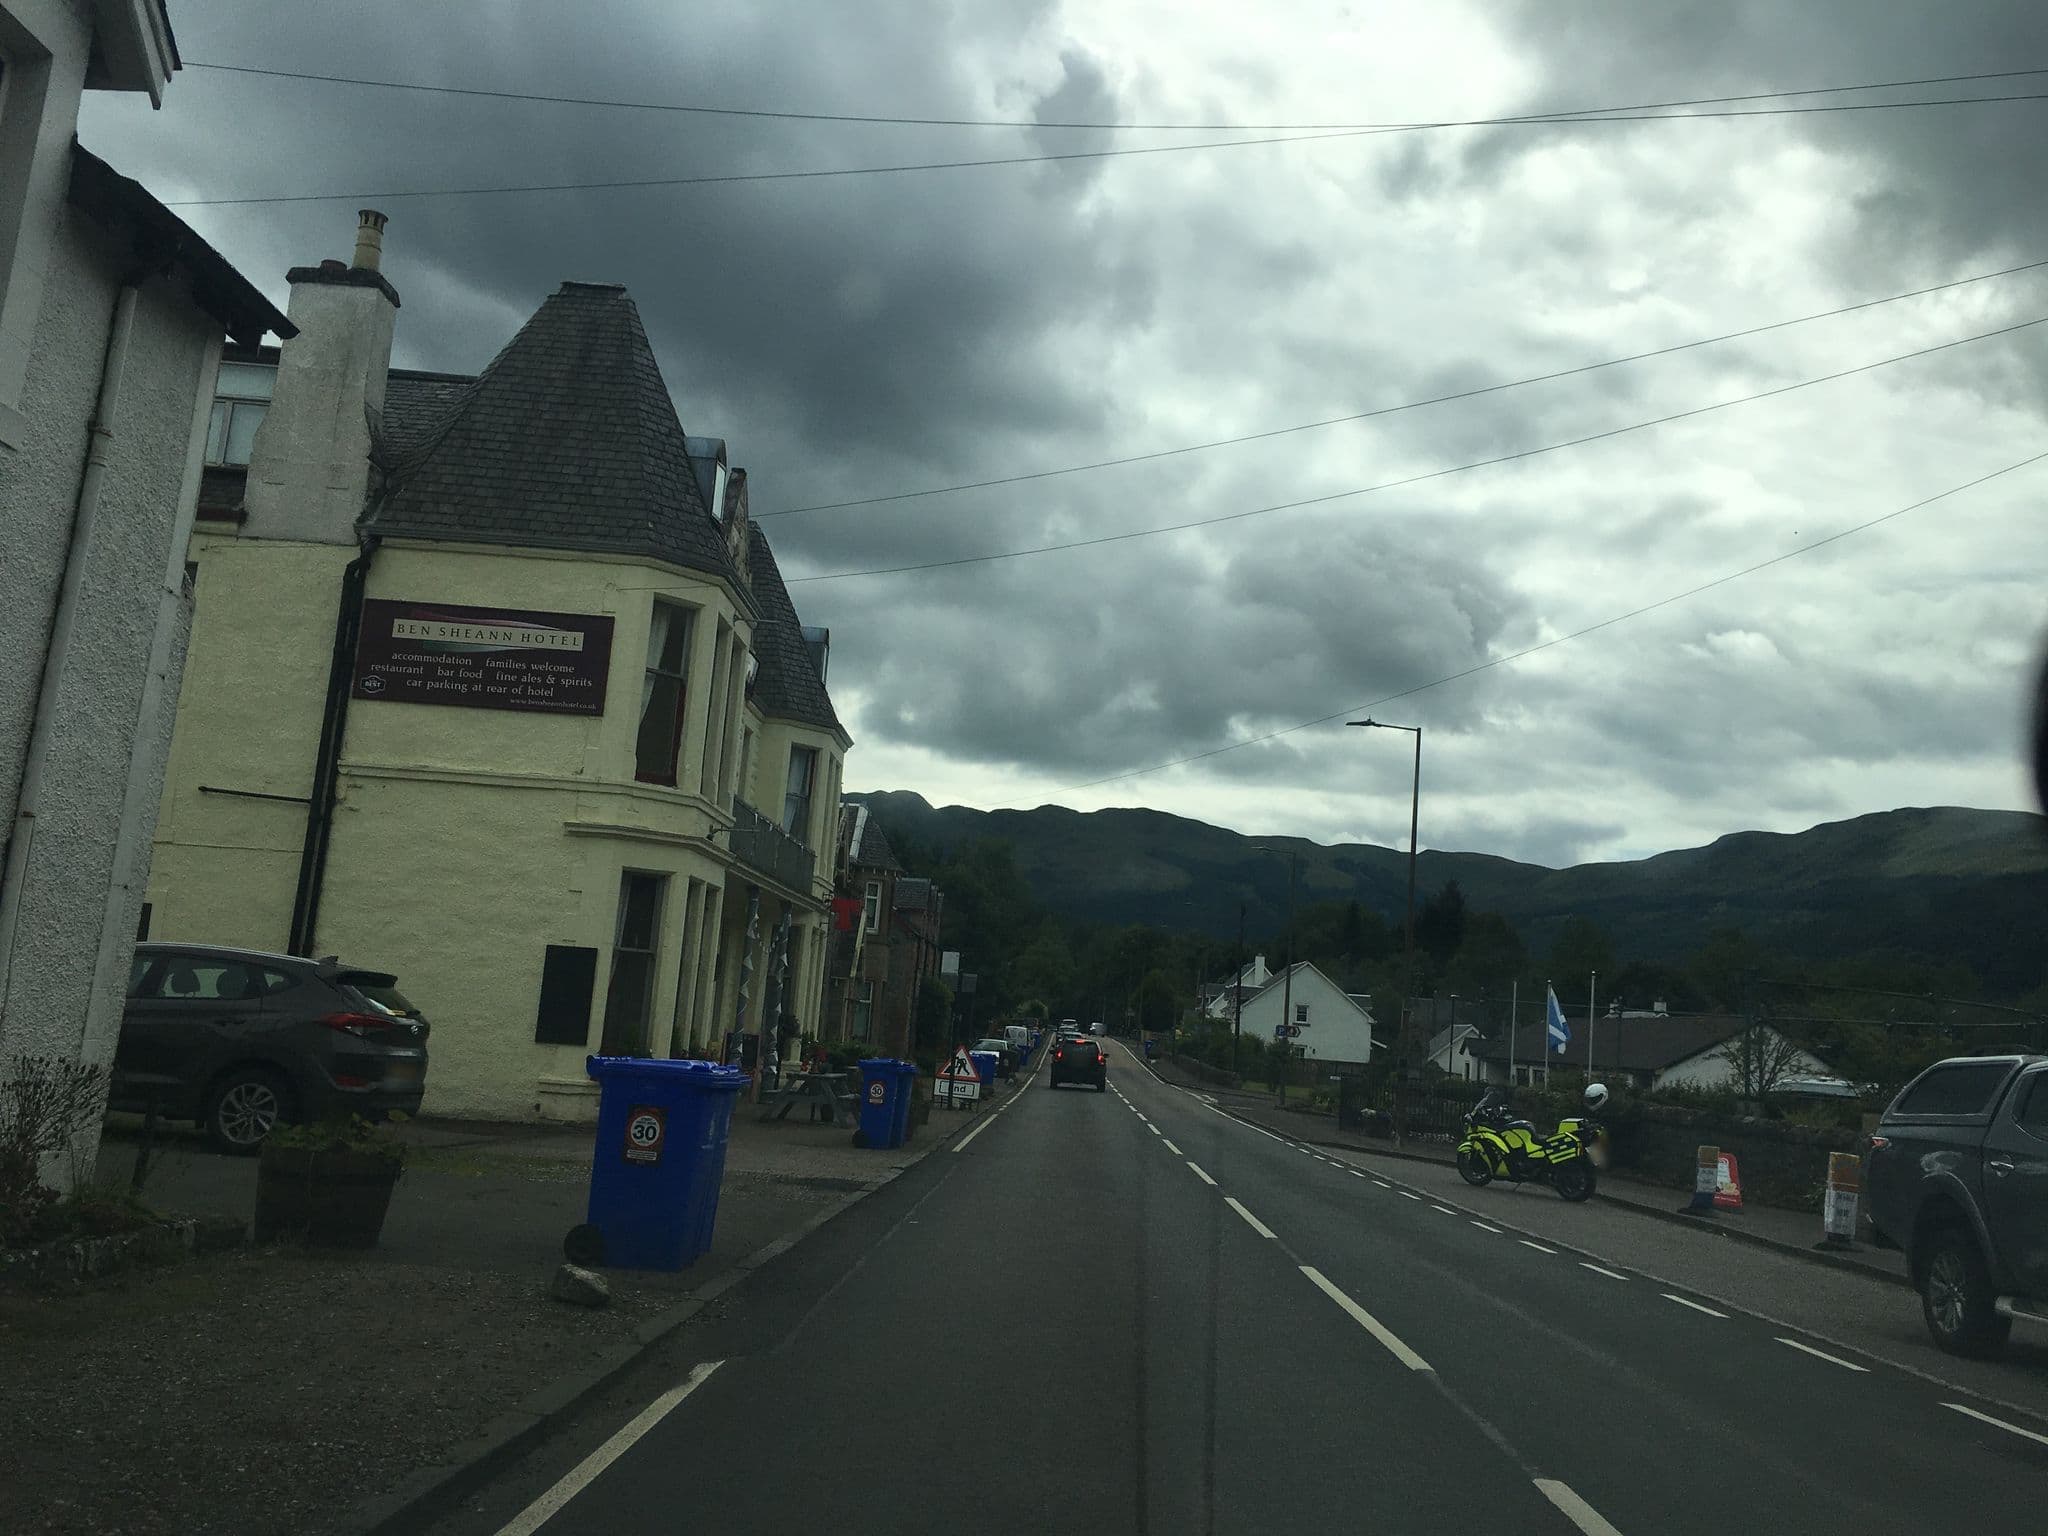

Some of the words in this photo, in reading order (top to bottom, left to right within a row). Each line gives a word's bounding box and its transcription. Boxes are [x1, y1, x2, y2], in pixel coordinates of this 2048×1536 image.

[397, 623, 430, 635] BEN
[439, 627, 513, 641] SHEANN
[521, 633, 579, 646] HOTEL
[391, 652, 472, 666] accommodation
[485, 657, 526, 670] families
[530, 661, 576, 673] welcome
[371, 663, 424, 674] restaurant
[437, 666, 454, 677] bar
[459, 667, 483, 679] food
[496, 671, 517, 682] fine
[521, 673, 542, 684] ales
[546, 674, 556, 684] &
[560, 677, 593, 688] spirits
[406, 678, 422, 687] car
[426, 680, 468, 693] parking
[471, 682, 482, 691] at
[486, 684, 508, 694] rear
[511, 685, 522, 695] of
[527, 686, 554, 697] hotel
[871, 1086, 883, 1096] 30
[632, 1124, 657, 1142] 30
